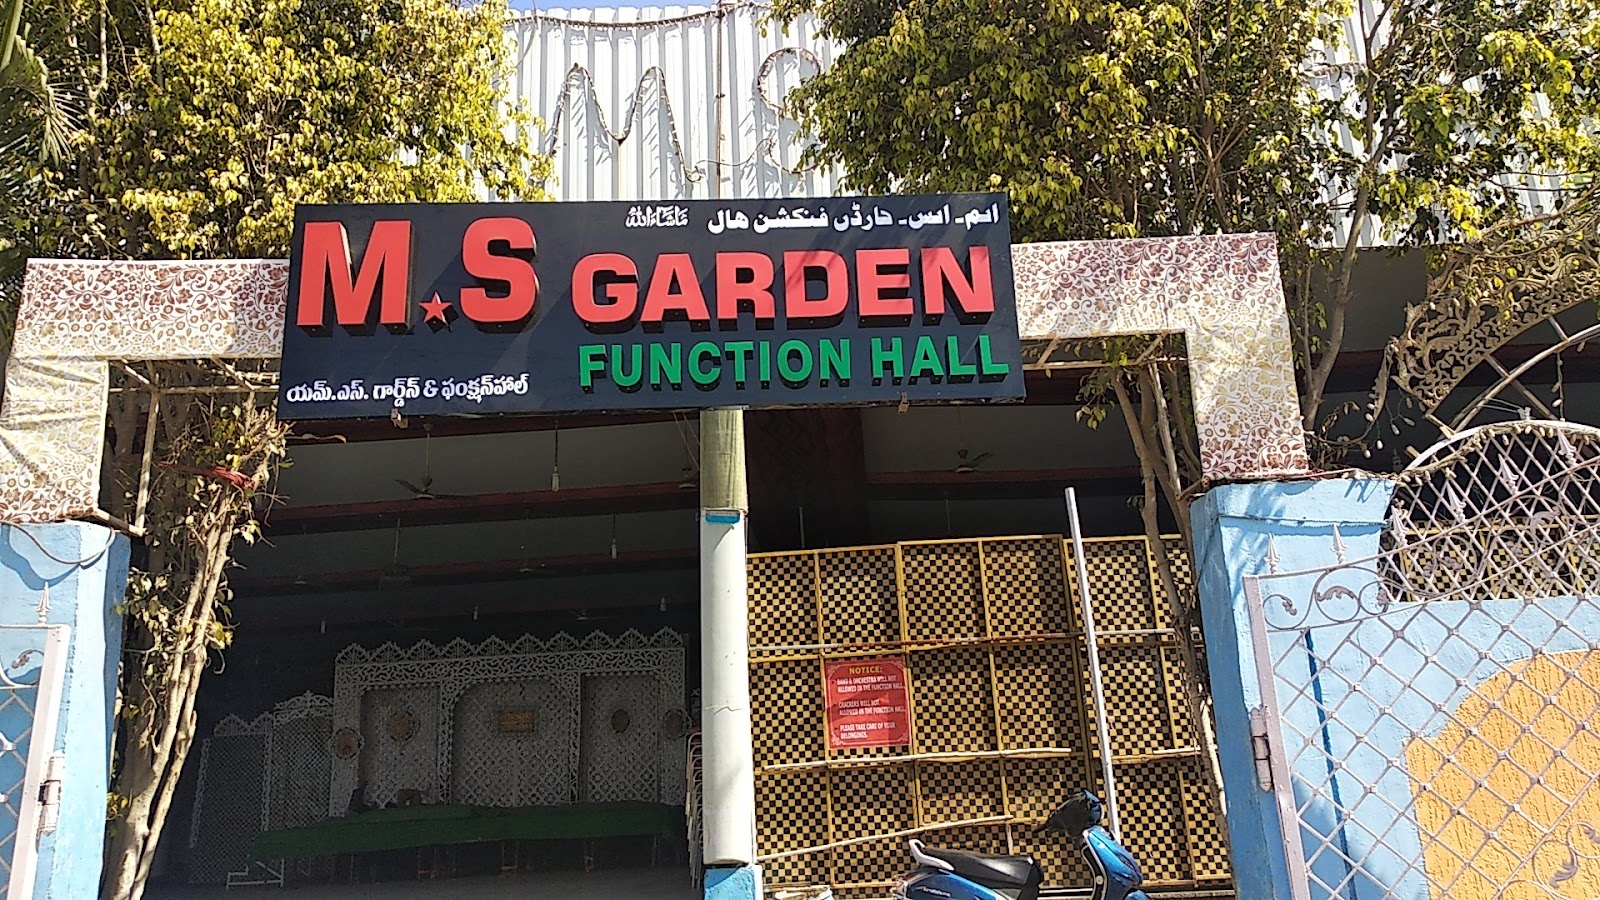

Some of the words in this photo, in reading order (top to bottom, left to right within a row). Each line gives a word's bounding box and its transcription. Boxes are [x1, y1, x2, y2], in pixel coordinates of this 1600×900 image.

[571, 246, 995, 330] GARDEN
[579, 338, 852, 391] FUNCTION
[871, 334, 1010, 385] HALL
[423, 379, 439, 398] &
[849, 666, 883, 674] NOTICE:
